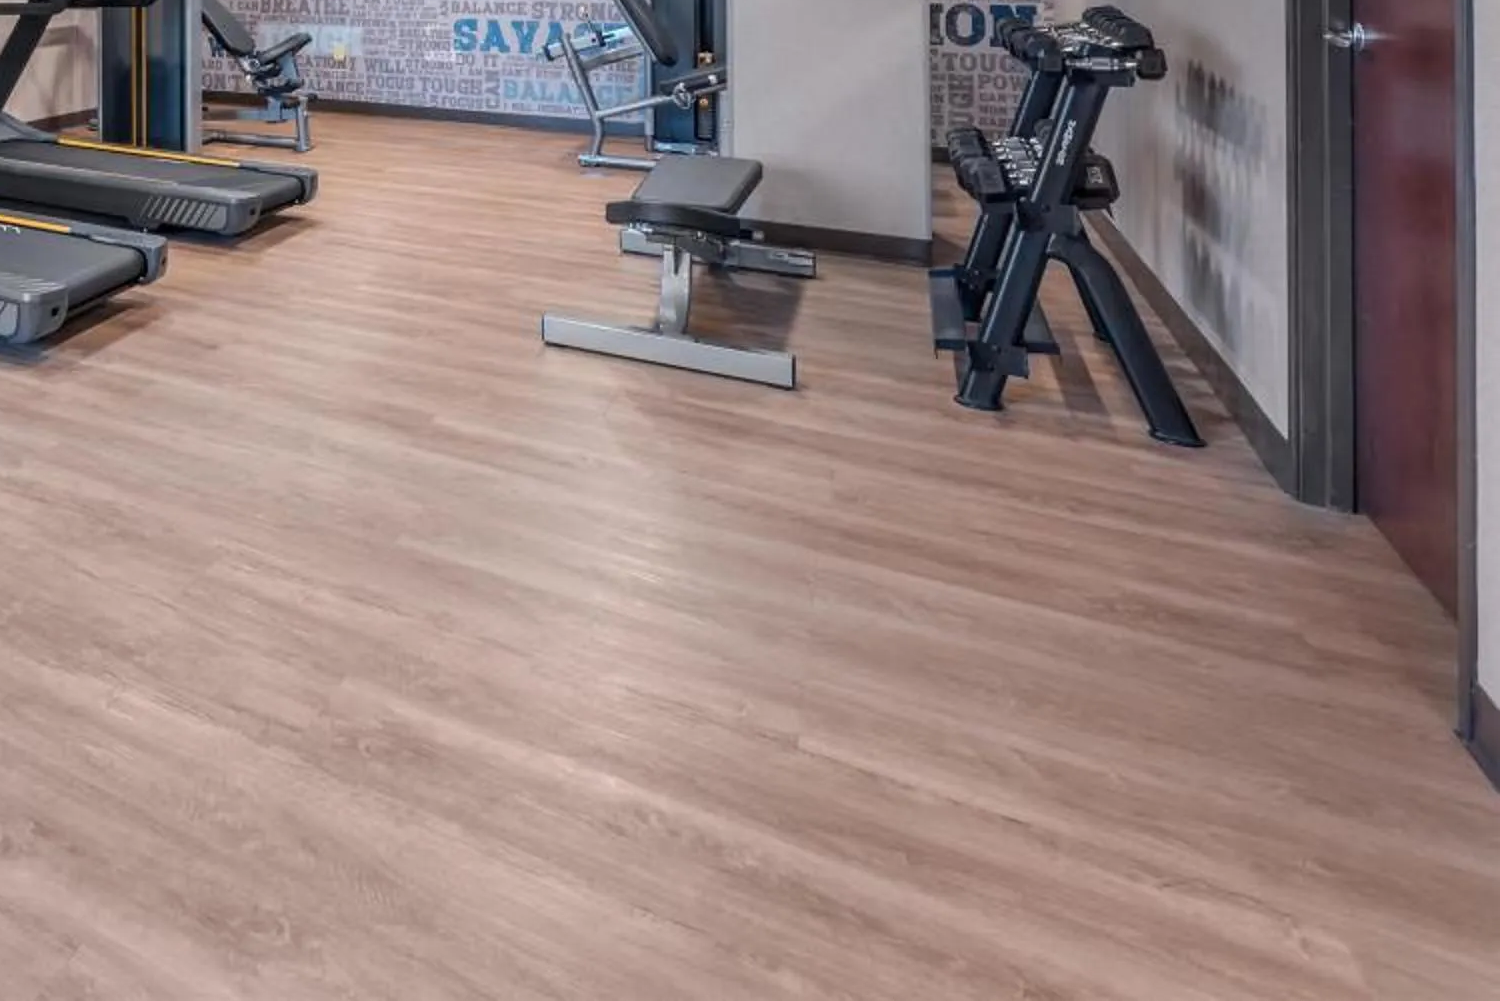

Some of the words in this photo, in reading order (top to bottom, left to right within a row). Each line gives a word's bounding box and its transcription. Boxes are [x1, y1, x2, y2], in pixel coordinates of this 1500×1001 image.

[450, 0, 528, 16] BALANCE
[929, 2, 1037, 47] ION
[364, 57, 405, 75] WILL
[941, 51, 1024, 73] TOUG
[200, 73, 246, 92] ON'T
[300, 78, 364, 96] ALANCE
[366, 75, 415, 91] FOCUS
[419, 76, 483, 97] TOUGH
[978, 74, 1023, 91] POW
